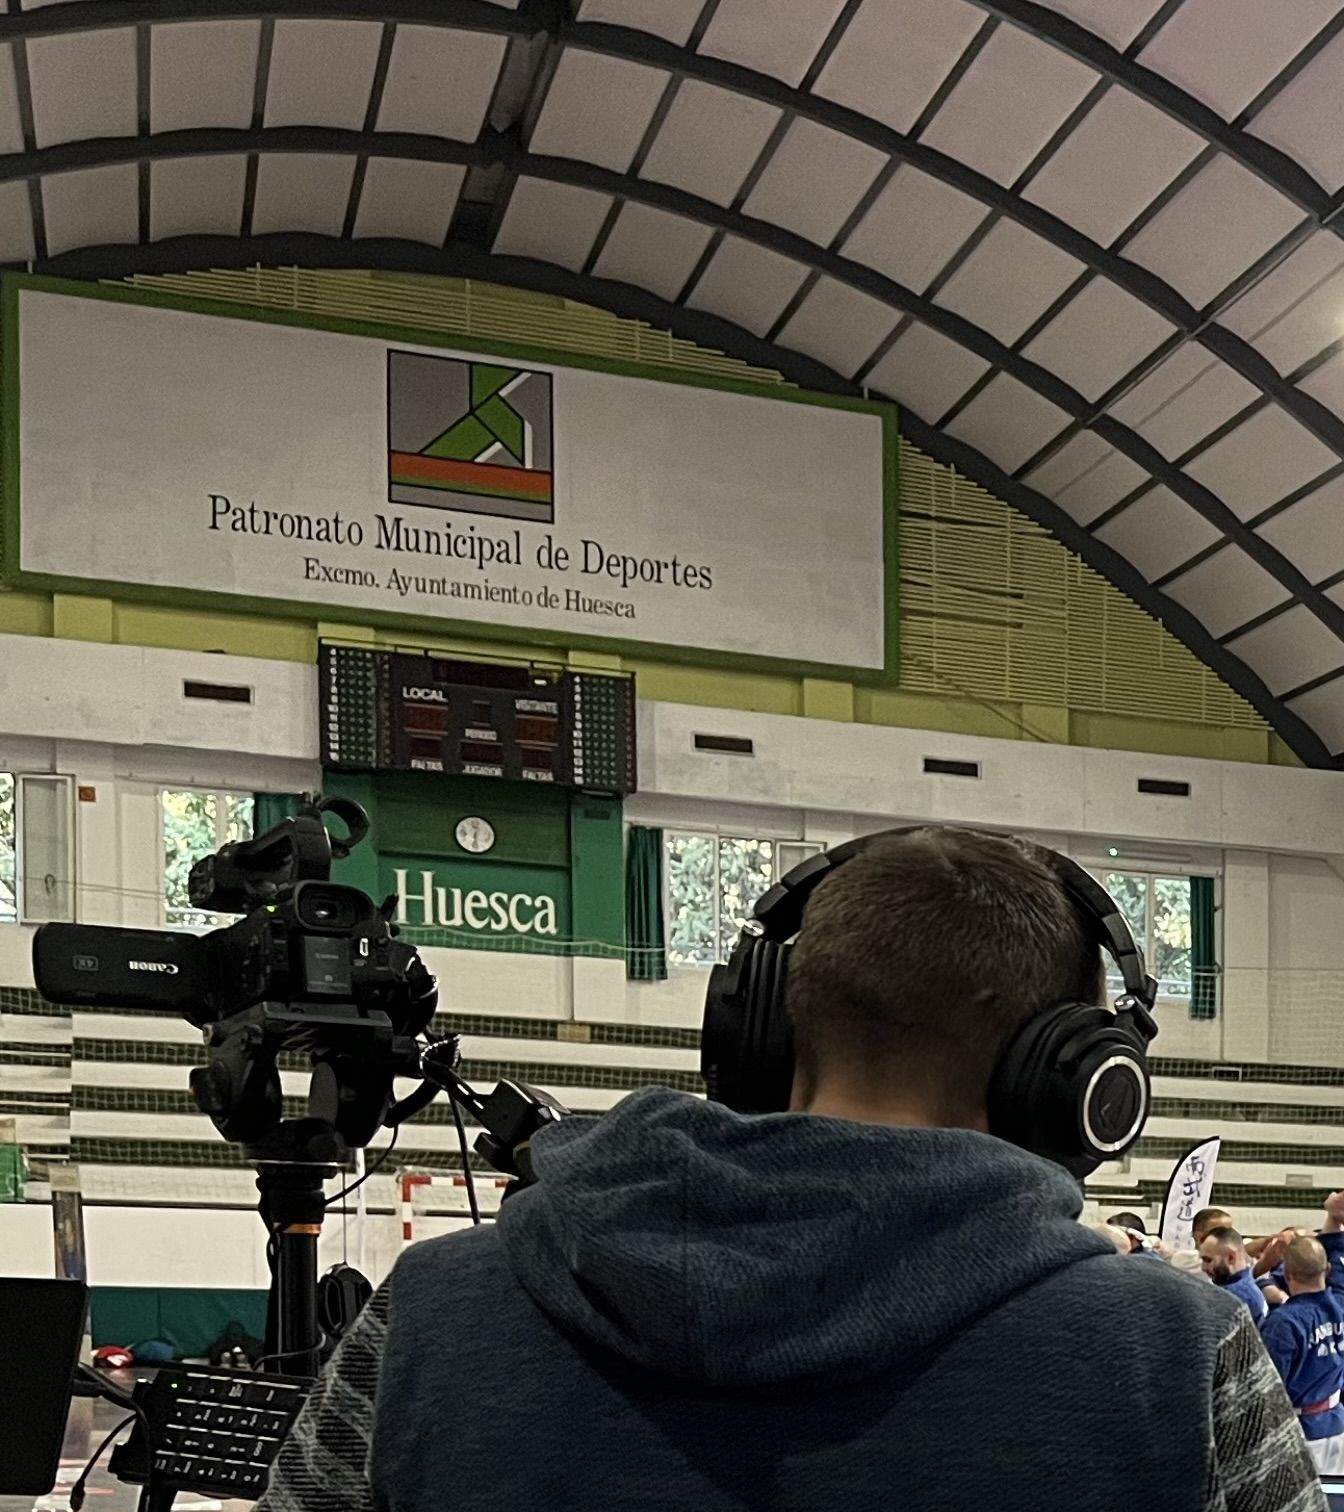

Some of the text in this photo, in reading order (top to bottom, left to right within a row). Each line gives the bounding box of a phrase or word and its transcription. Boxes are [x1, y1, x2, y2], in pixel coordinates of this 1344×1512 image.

[208, 494, 712, 590] Patronato Municipal de Deportes
[303, 557, 636, 619] Excmo. Ayuntamiento de Huesca
[402, 686, 447, 701] LOCAL
[394, 868, 558, 935] Huesca
[128, 960, 179, 975] Canon
